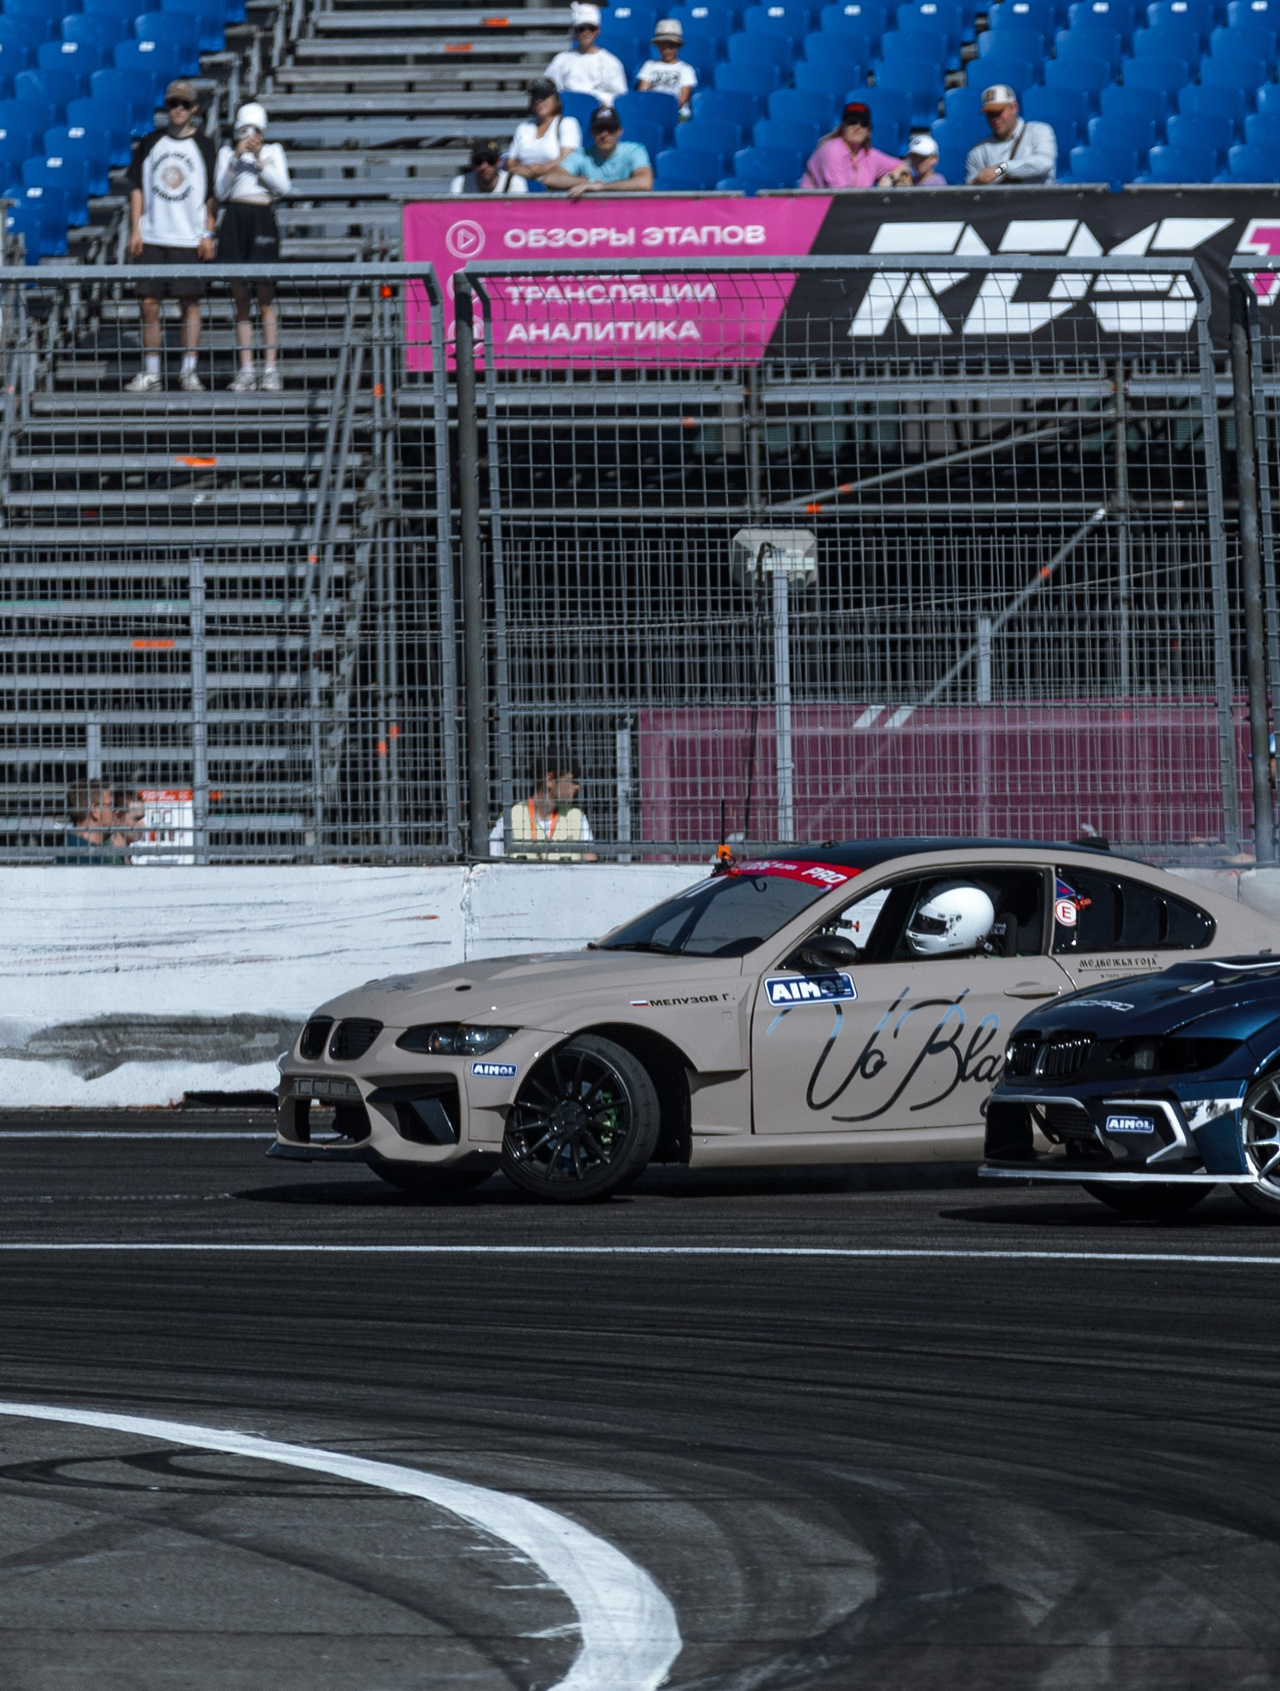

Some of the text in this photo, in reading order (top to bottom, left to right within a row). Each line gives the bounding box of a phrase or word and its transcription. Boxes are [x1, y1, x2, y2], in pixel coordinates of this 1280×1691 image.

[503, 224, 766, 249] ОБЗОРЫ ЭТАПОВ
[847, 217, 1236, 336] RDS
[505, 282, 717, 306] ТРАНСЛЯЦИИ
[506, 320, 701, 342] АНАЛИТИКА
[1061, 906, 1072, 919] E
[649, 994, 719, 1007] МЕЛУЗОВ
[772, 979, 852, 1001] AIMOL
[473, 1064, 515, 1075] AIMOL
[1108, 1119, 1152, 1130] AIMOL
